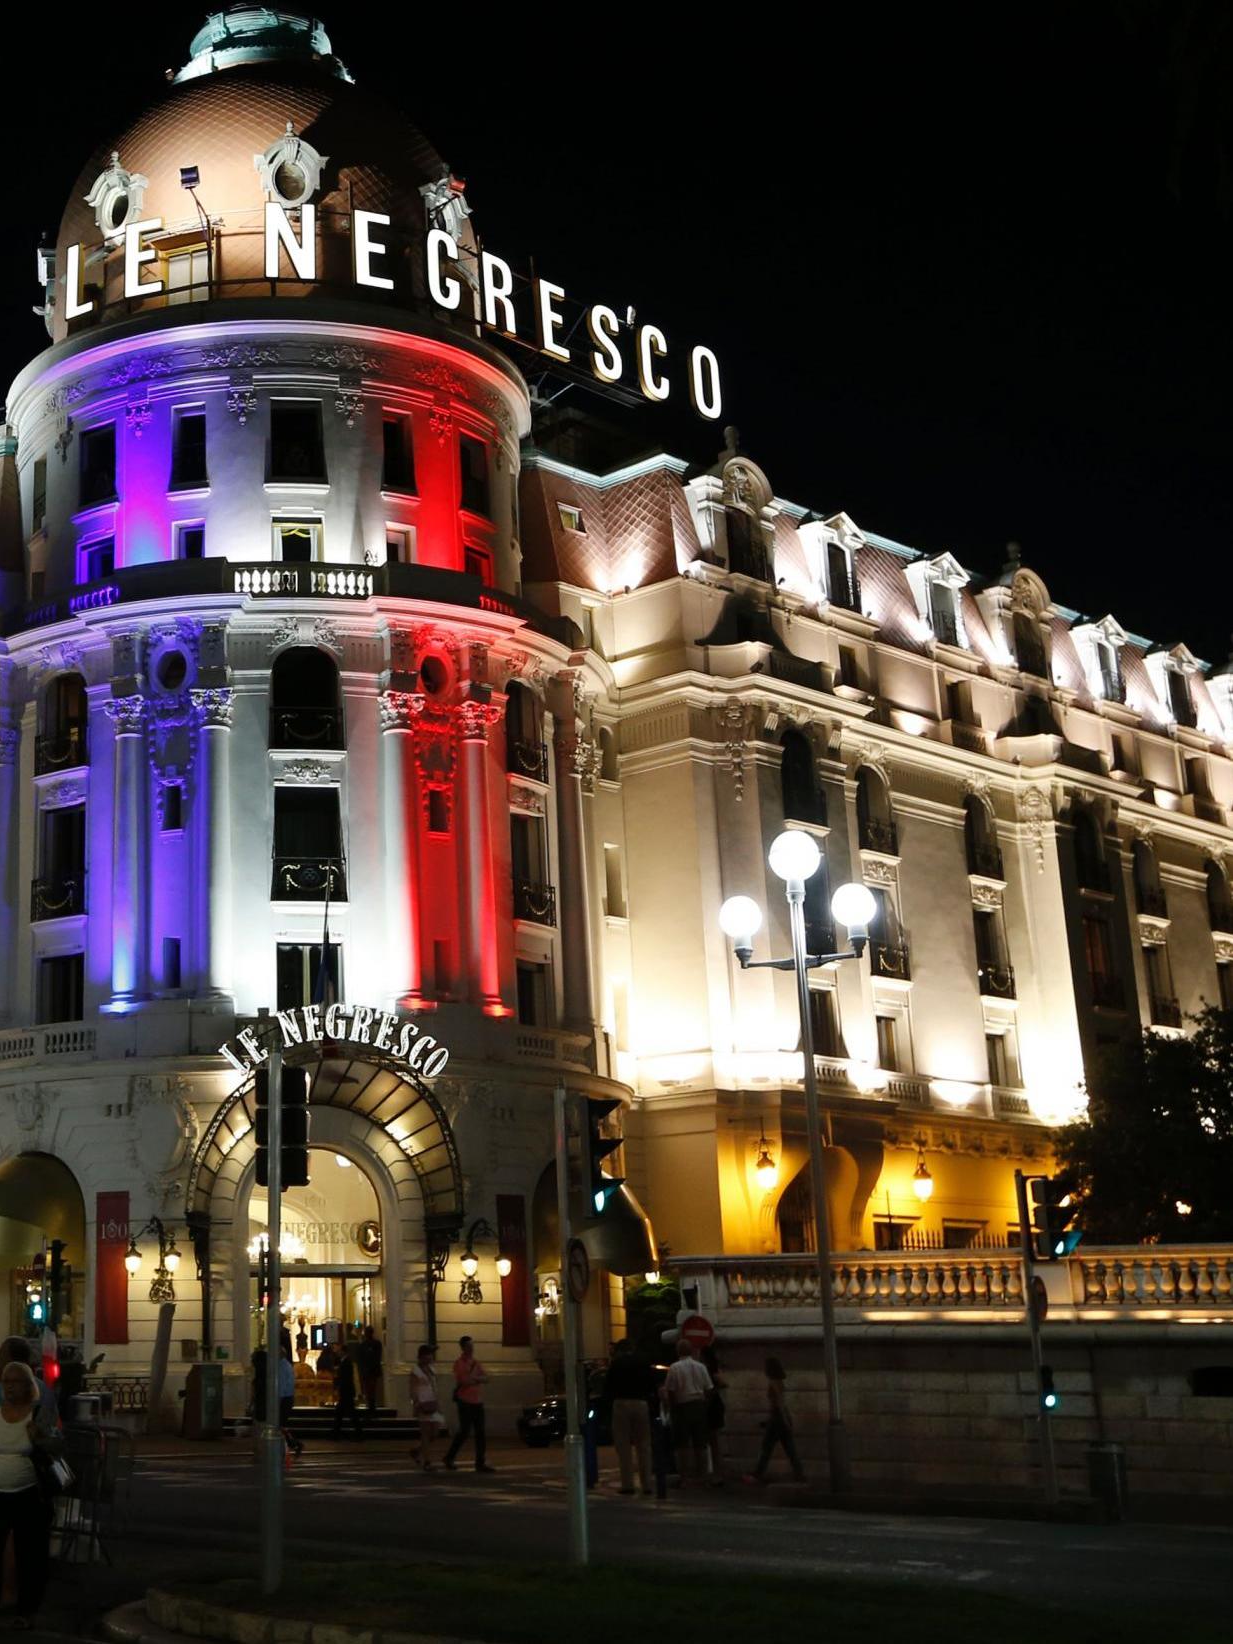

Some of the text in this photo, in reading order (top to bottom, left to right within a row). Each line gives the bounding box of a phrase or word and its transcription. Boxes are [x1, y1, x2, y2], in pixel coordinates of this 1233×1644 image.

[65, 201, 723, 420] LE NEGRESCO
[218, 1002, 450, 1079] LE NEGRESCO
